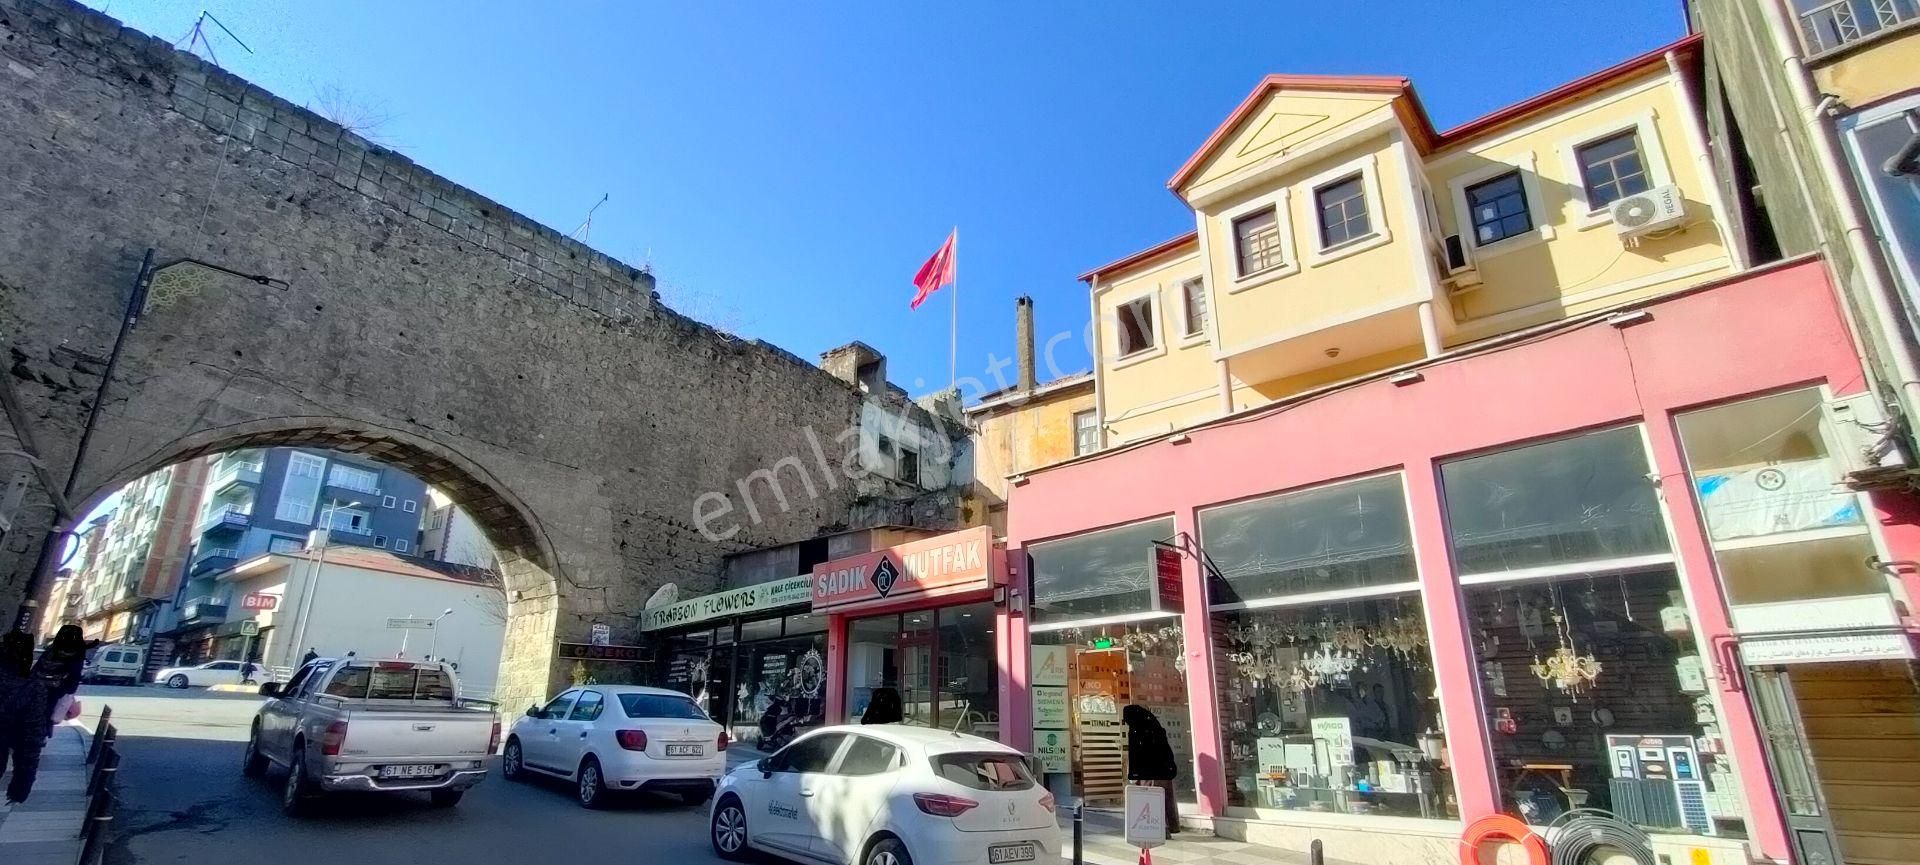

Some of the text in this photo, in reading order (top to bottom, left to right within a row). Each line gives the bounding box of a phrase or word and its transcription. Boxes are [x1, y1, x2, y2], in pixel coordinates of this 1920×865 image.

[1661, 188, 1676, 214] REGAL
[818, 539, 983, 598] SADIK MUTFAK
[770, 584, 784, 596] KALE
[653, 602, 698, 627] TRABZON
[703, 590, 756, 616] FLOWERS
[386, 765, 433, 775] 61 NE 516
[994, 846, 1033, 861] 61 AEV 399
